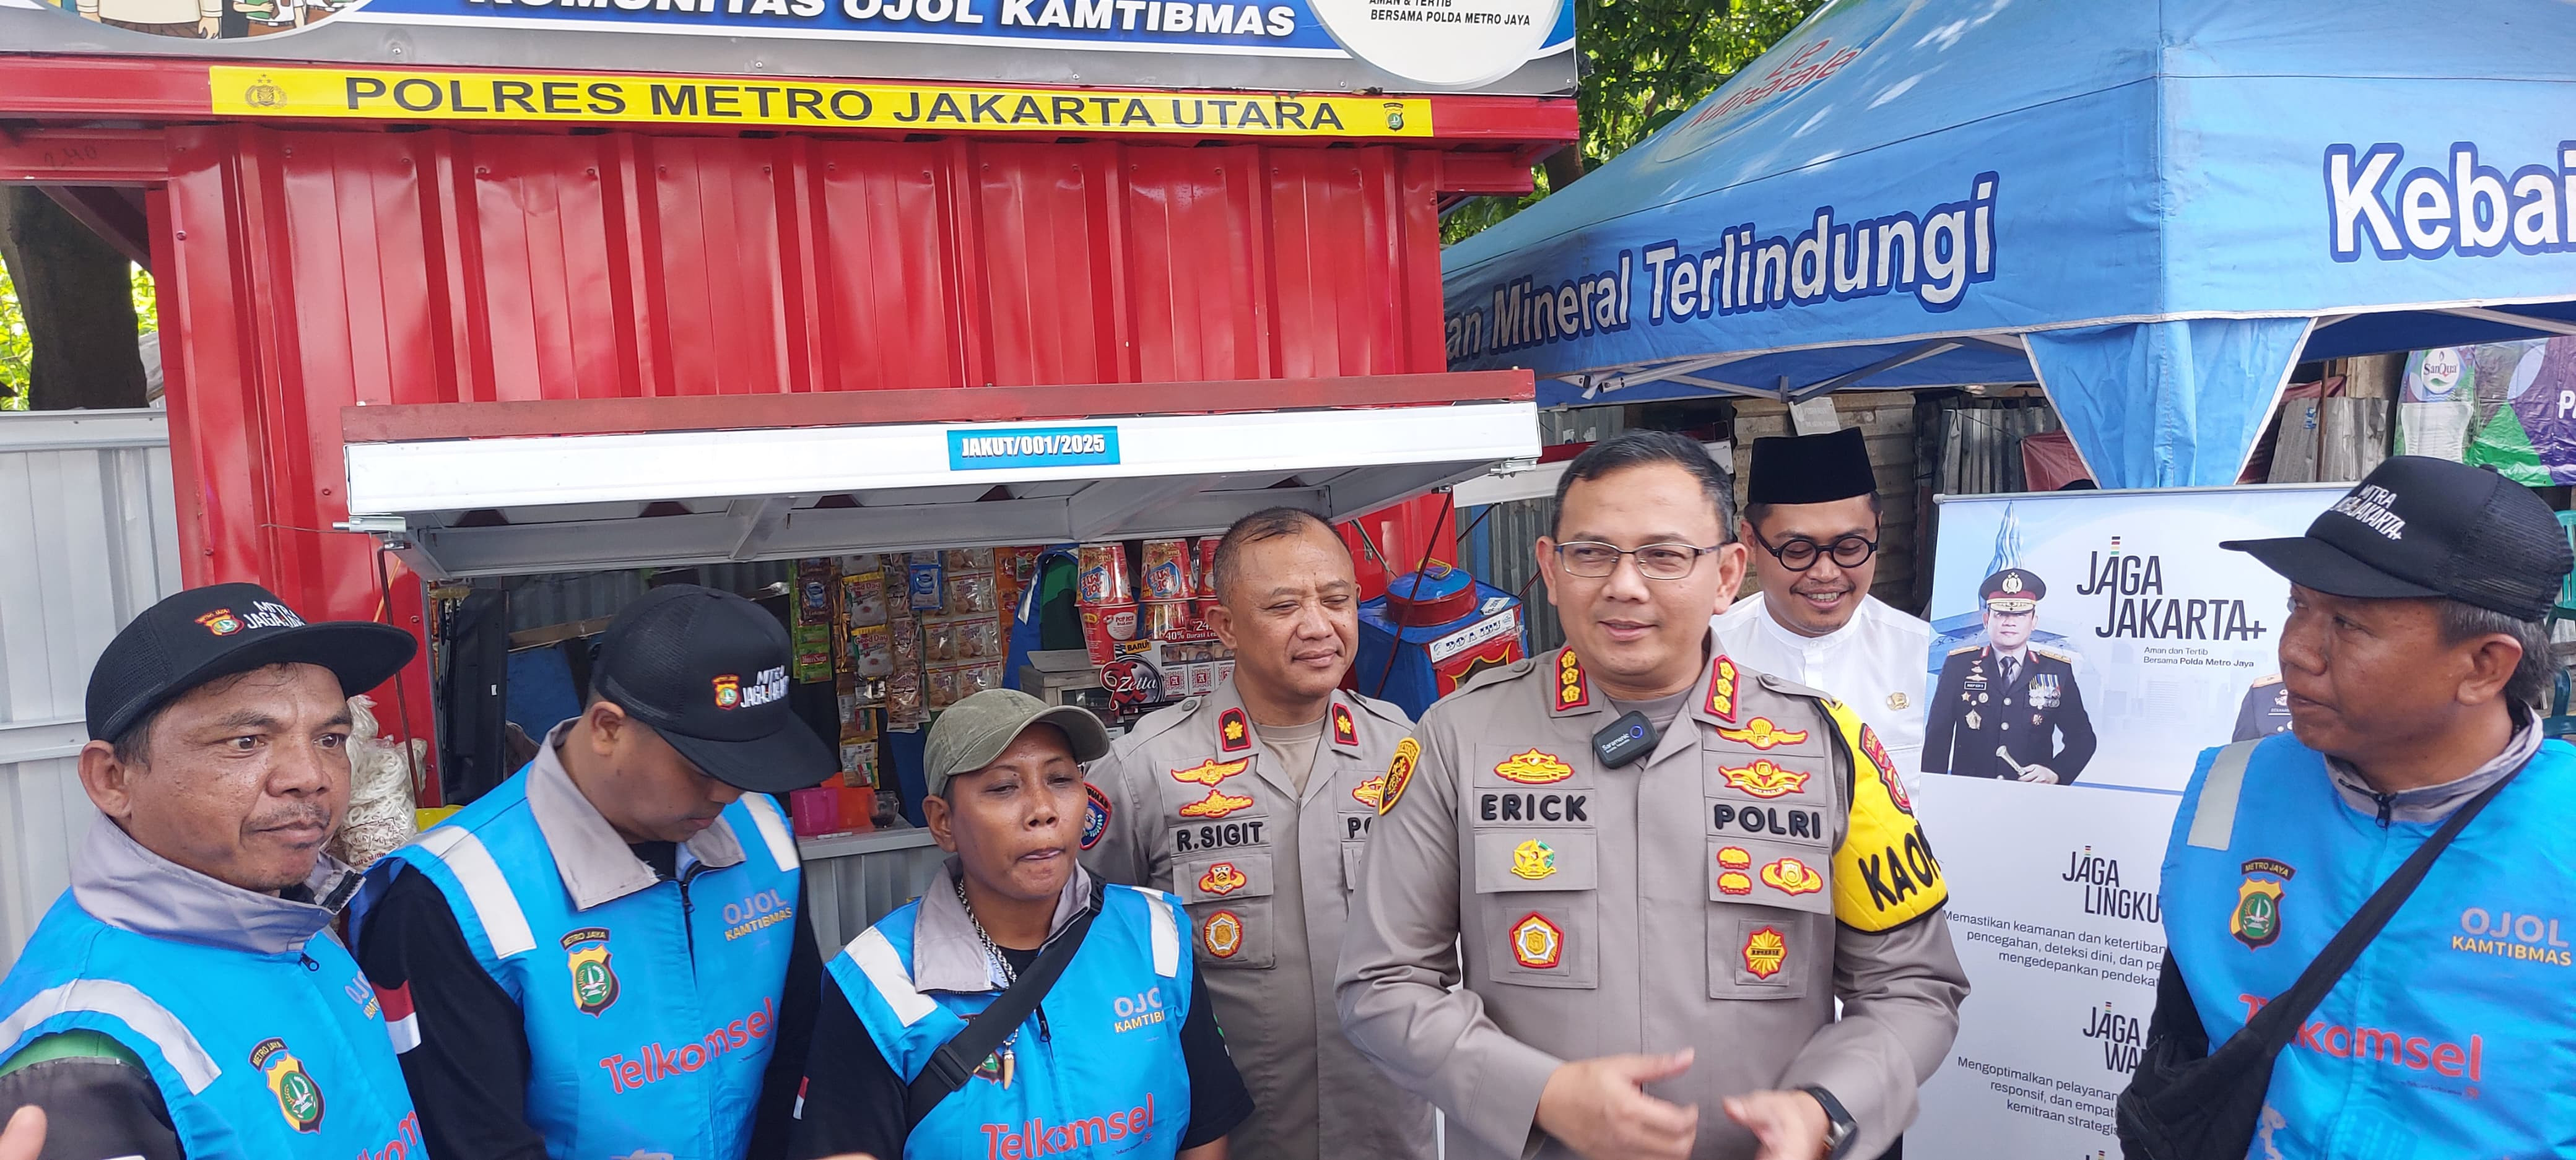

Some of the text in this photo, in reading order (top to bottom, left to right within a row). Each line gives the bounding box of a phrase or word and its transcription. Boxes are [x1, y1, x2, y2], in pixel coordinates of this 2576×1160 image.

[1001, 0, 1295, 36] KAMTIBMAS
[1370, 9, 1531, 26] BERSAMA POLDA METRO JAYA
[1764, 38, 1830, 80] Le
[346, 77, 1344, 130] POLRES METRO JAKARTA UTARA
[1672, 46, 1860, 136] Minerale
[1492, 256, 1630, 349] Mineral
[1646, 181, 1993, 320] Terlindungi
[2424, 362, 2458, 378] SanQua
[2559, 390, 2576, 419] P
[962, 435, 1105, 457] JAKUT/001/2025
[2076, 550, 2163, 595] JAGA
[2095, 577, 2267, 641] JAKARTA+
[855, 633, 888, 645] Good Day
[1165, 631, 1185, 640] 40%
[2144, 646, 2167, 655] Aman
[2144, 656, 2178, 664] Bersama
[2206, 659, 2232, 667] Metro
[2234, 660, 2255, 669] Jaya
[1481, 794, 1587, 822] ERICK
[1714, 804, 1821, 839] POLRI
[1177, 821, 1263, 852] R.SIGIT
[2062, 851, 2120, 888] JAGA
[2245, 862, 2289, 877] METRO JAYA
[723, 889, 787, 925] OJOL
[724, 907, 793, 941] KAMTIBMAS
[1944, 910, 2011, 930] Memastikan
[2014, 920, 2075, 940] keamanan
[2079, 933, 2101, 945] dan
[2461, 907, 2569, 948] OJOL
[1967, 930, 2041, 953] pencegahan,
[2045, 942, 2088, 959] deteksi
[2091, 950, 2116, 964] dini,
[2120, 954, 2143, 967] dan
[1999, 951, 2098, 978] mengedepankan
[2452, 936, 2572, 966] KAMTIBMAS
[2083, 1006, 2141, 1047] JAGA
[2237, 993, 2483, 1082] Tkomsel
[599, 997, 774, 1094] Telkomsel
[1958, 1056, 2118, 1102] Mengoptimalkan pelayanan
[1991, 1081, 2047, 1104] responsif,
[2050, 1094, 2073, 1108] dan
[980, 1093, 1154, 1160] Telkomsel
[2007, 1099, 2065, 1123] kemitraan
